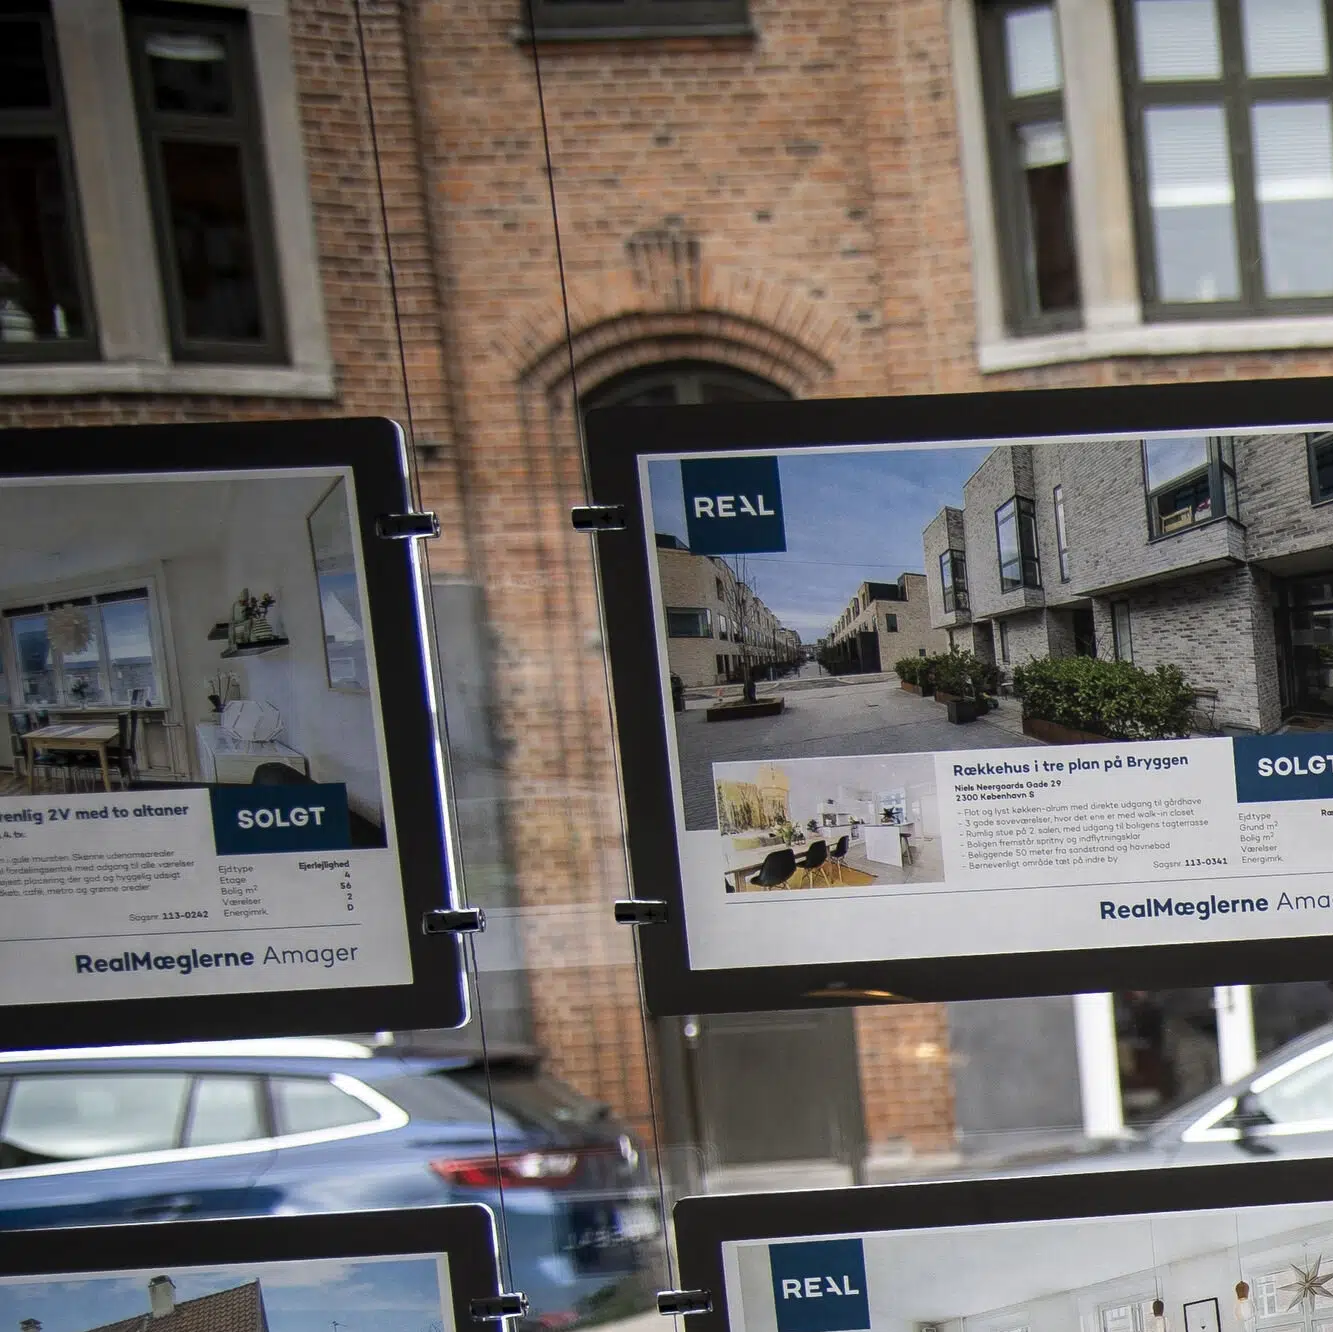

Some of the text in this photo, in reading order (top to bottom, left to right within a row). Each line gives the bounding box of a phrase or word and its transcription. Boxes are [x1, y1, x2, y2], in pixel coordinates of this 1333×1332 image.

[693, 494, 775, 518] REAL
[952, 754, 1188, 776] Rækkehus i tre plan på Bryggen
[954, 783, 974, 792] Niels
[975, 781, 1024, 792] Neergaards
[1025, 779, 1048, 789] Gade
[955, 793, 978, 802] 2300
[979, 790, 1027, 800] København
[47, 807, 70, 821] 2V
[74, 805, 109, 820] med
[111, 806, 129, 818] to
[132, 803, 189, 817] altaner
[237, 805, 325, 829] SOLGT
[1184, 857, 1228, 866] 113-0341
[162, 910, 209, 920] 113-0242
[1099, 894, 1268, 920] RealMæglerne
[74, 945, 358, 975] RealMæglerne Amager
[782, 1275, 860, 1299] REAL
